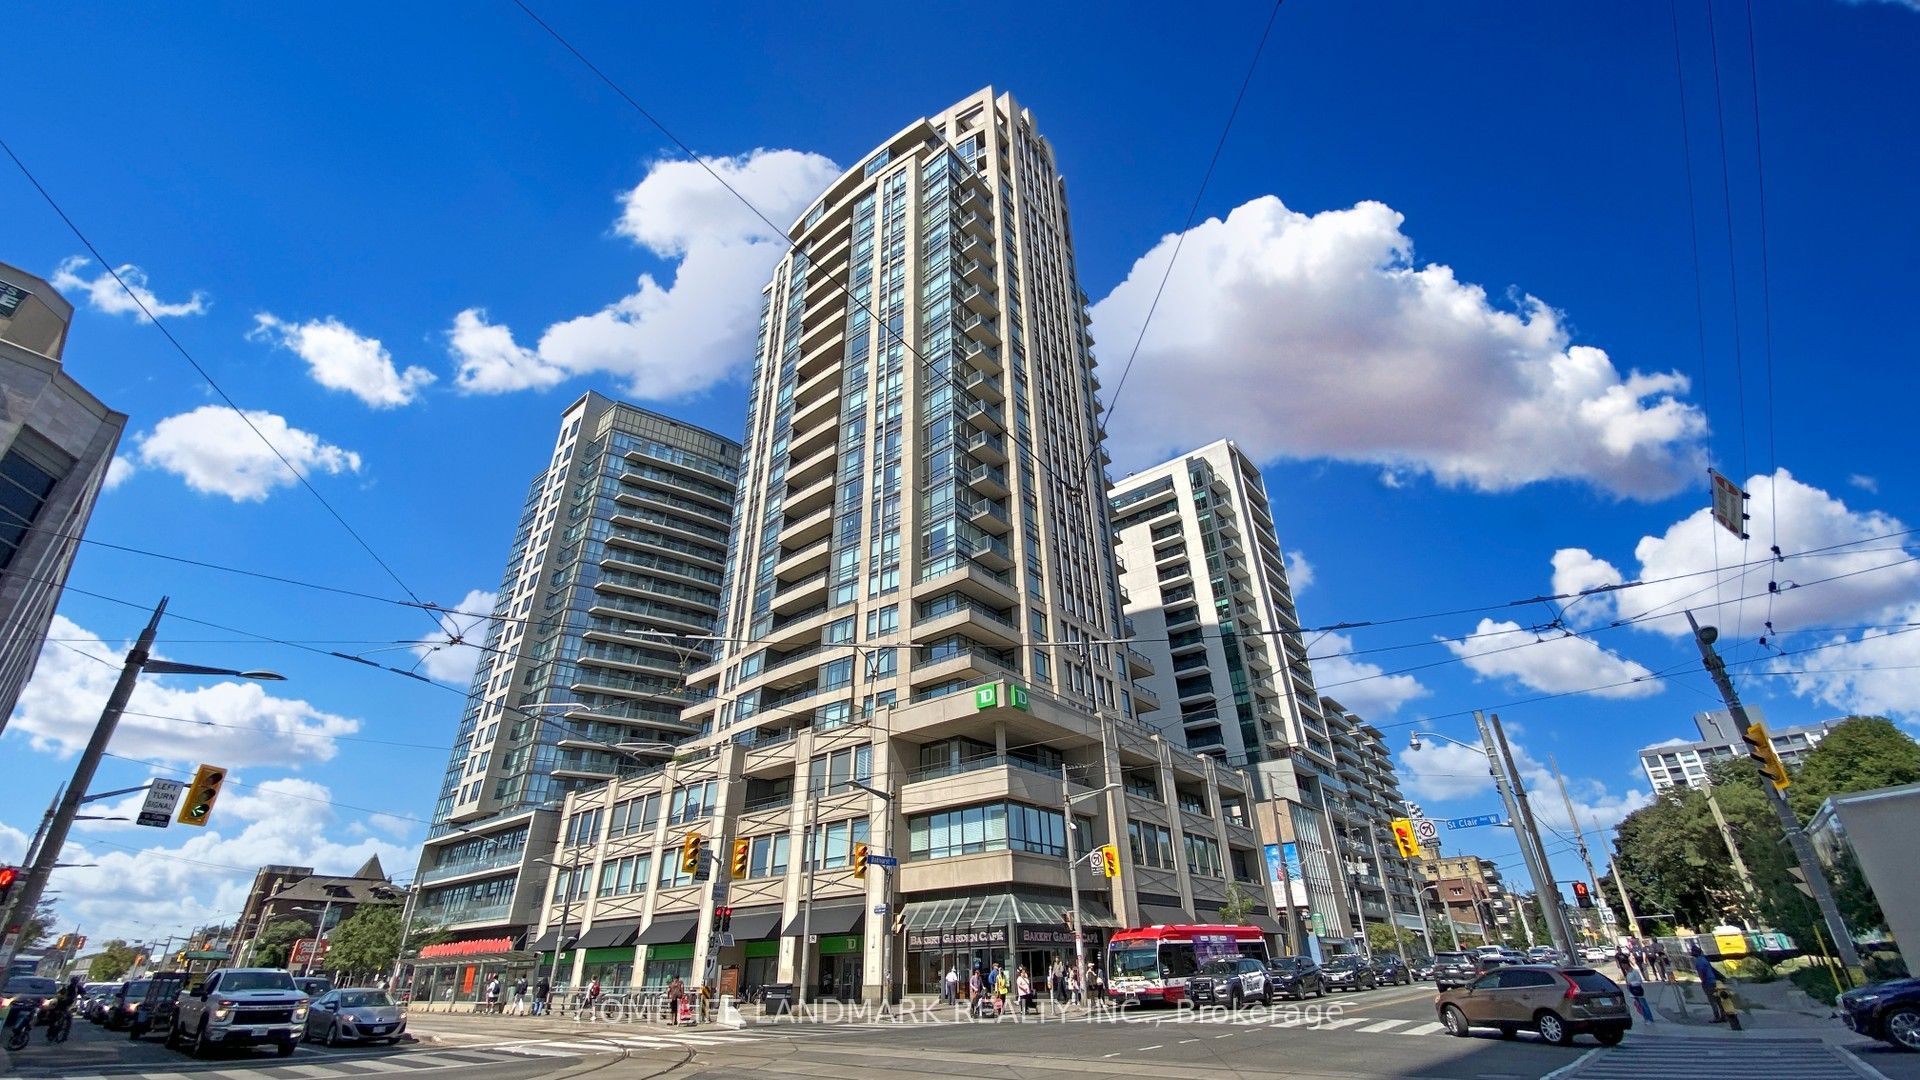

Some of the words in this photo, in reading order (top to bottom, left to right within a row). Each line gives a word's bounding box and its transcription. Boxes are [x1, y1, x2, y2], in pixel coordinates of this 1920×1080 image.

[978, 689, 993, 703] TD
[1016, 689, 1027, 704] TD
[157, 782, 178, 791] LEFT
[153, 791, 176, 800] TURN
[147, 800, 172, 810] SIGNAL
[1447, 821, 1456, 829] St
[1459, 819, 1478, 827] Clair
[1489, 815, 1497, 823] W
[1603, 913, 1613, 921] 40
[910, 936, 940, 945] BAKERY
[1023, 930, 1052, 941] BAKERY
[1053, 931, 1076, 942] GARD
